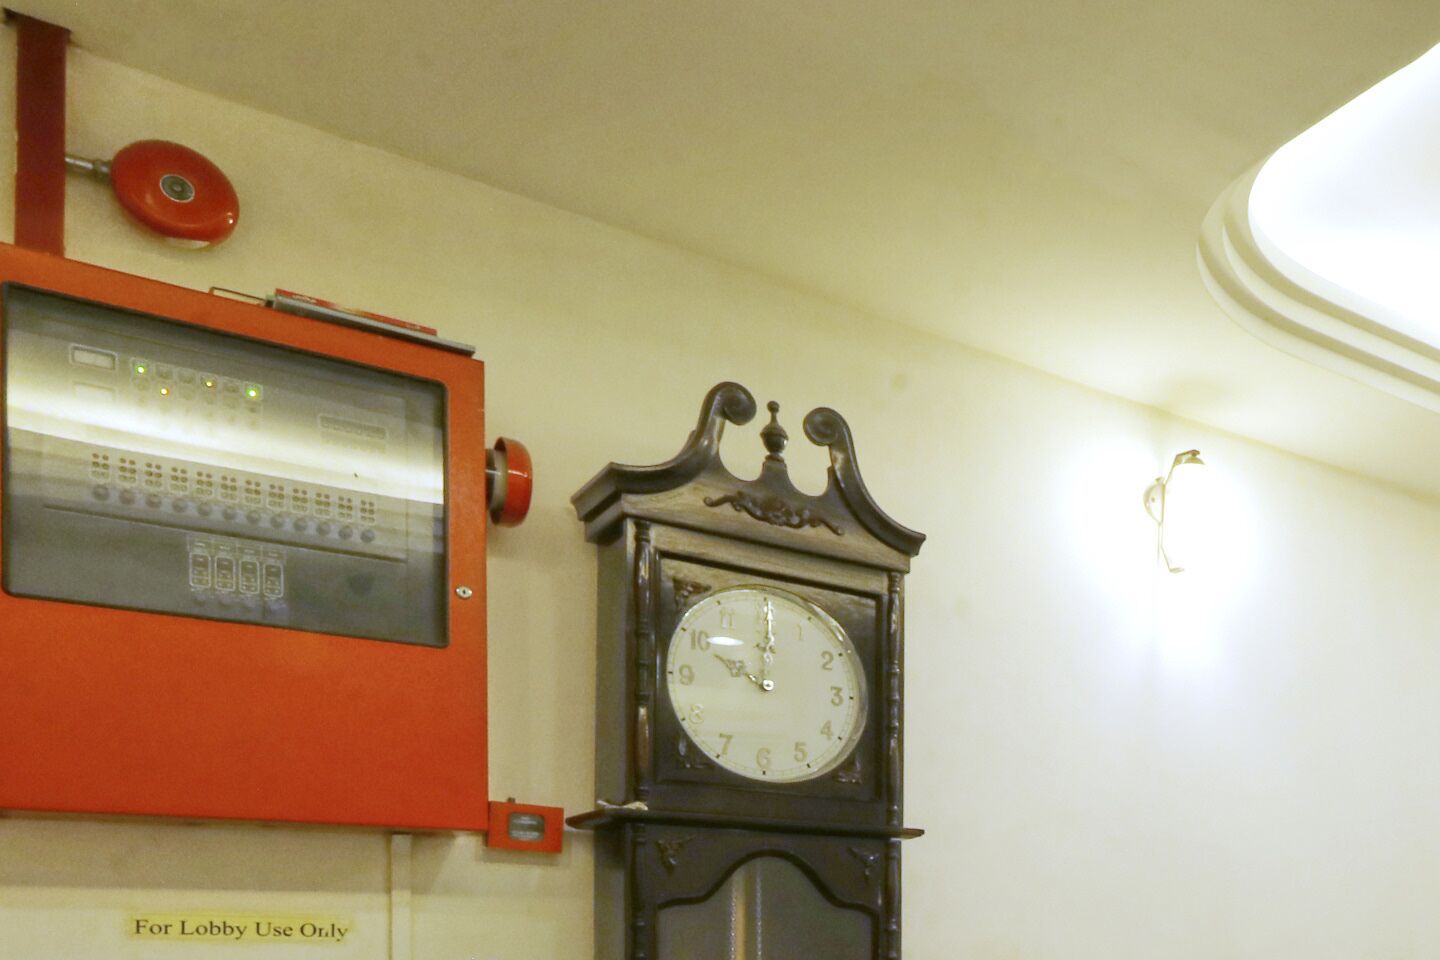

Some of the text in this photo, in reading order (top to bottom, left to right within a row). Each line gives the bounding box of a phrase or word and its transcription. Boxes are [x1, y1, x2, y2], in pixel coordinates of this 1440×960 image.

[690, 630, 711, 651] 10
[820, 651, 834, 671] 2
[679, 665, 695, 686] 9
[830, 686, 844, 707] 3
[688, 702, 705, 725] 8
[820, 720, 834, 741] 4
[719, 733, 735, 756] 7
[794, 742, 808, 763] 5
[756, 748, 771, 769] 6
[135, 919, 349, 943] For Lobby Use Only
